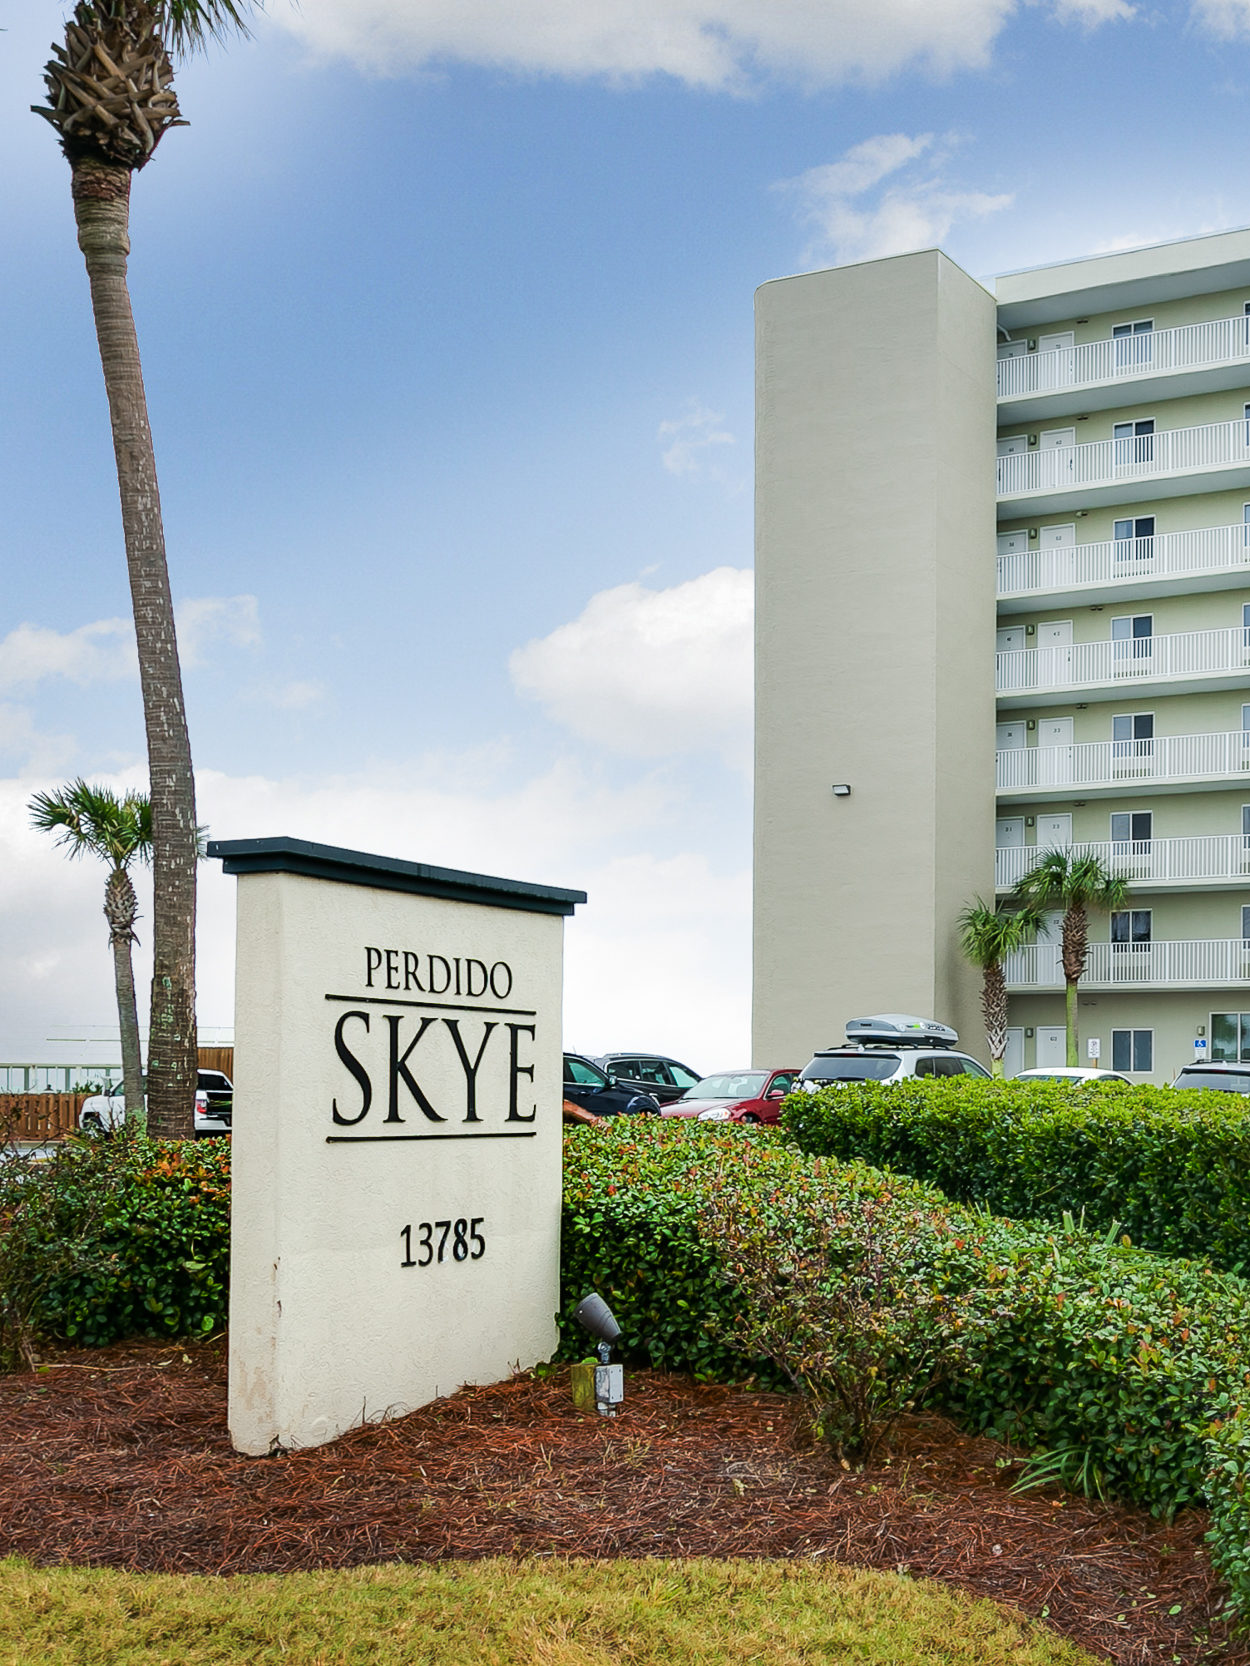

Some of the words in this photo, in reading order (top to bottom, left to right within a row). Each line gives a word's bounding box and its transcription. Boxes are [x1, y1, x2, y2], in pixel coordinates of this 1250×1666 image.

[364, 946, 513, 1000] PERDIDO
[332, 1010, 537, 1127] SKYE
[400, 1217, 486, 1268] 13785
